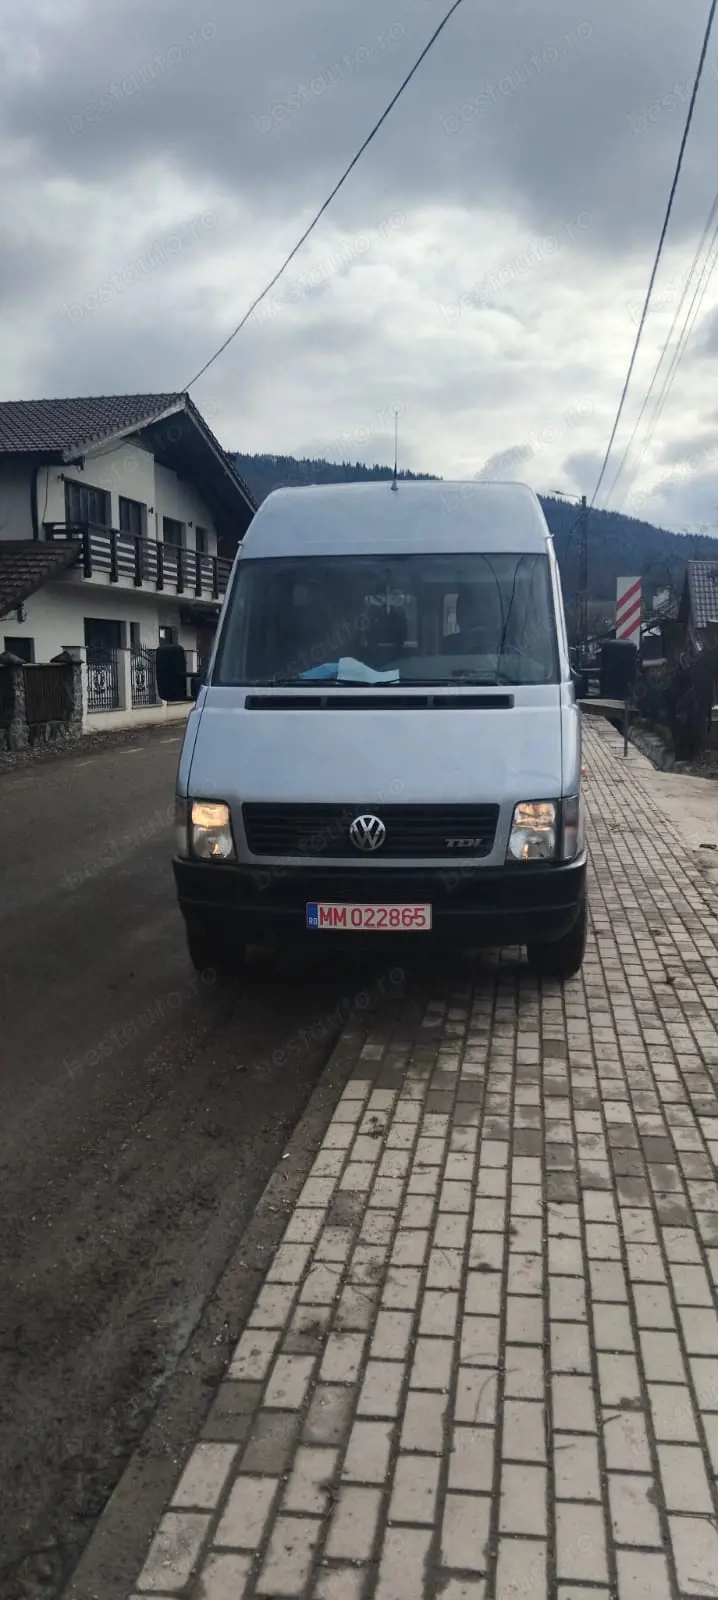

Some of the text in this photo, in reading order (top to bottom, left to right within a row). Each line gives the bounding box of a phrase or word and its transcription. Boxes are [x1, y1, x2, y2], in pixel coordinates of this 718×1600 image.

[445, 838, 482, 848] TDI
[319, 907, 426, 927] MM 022865
